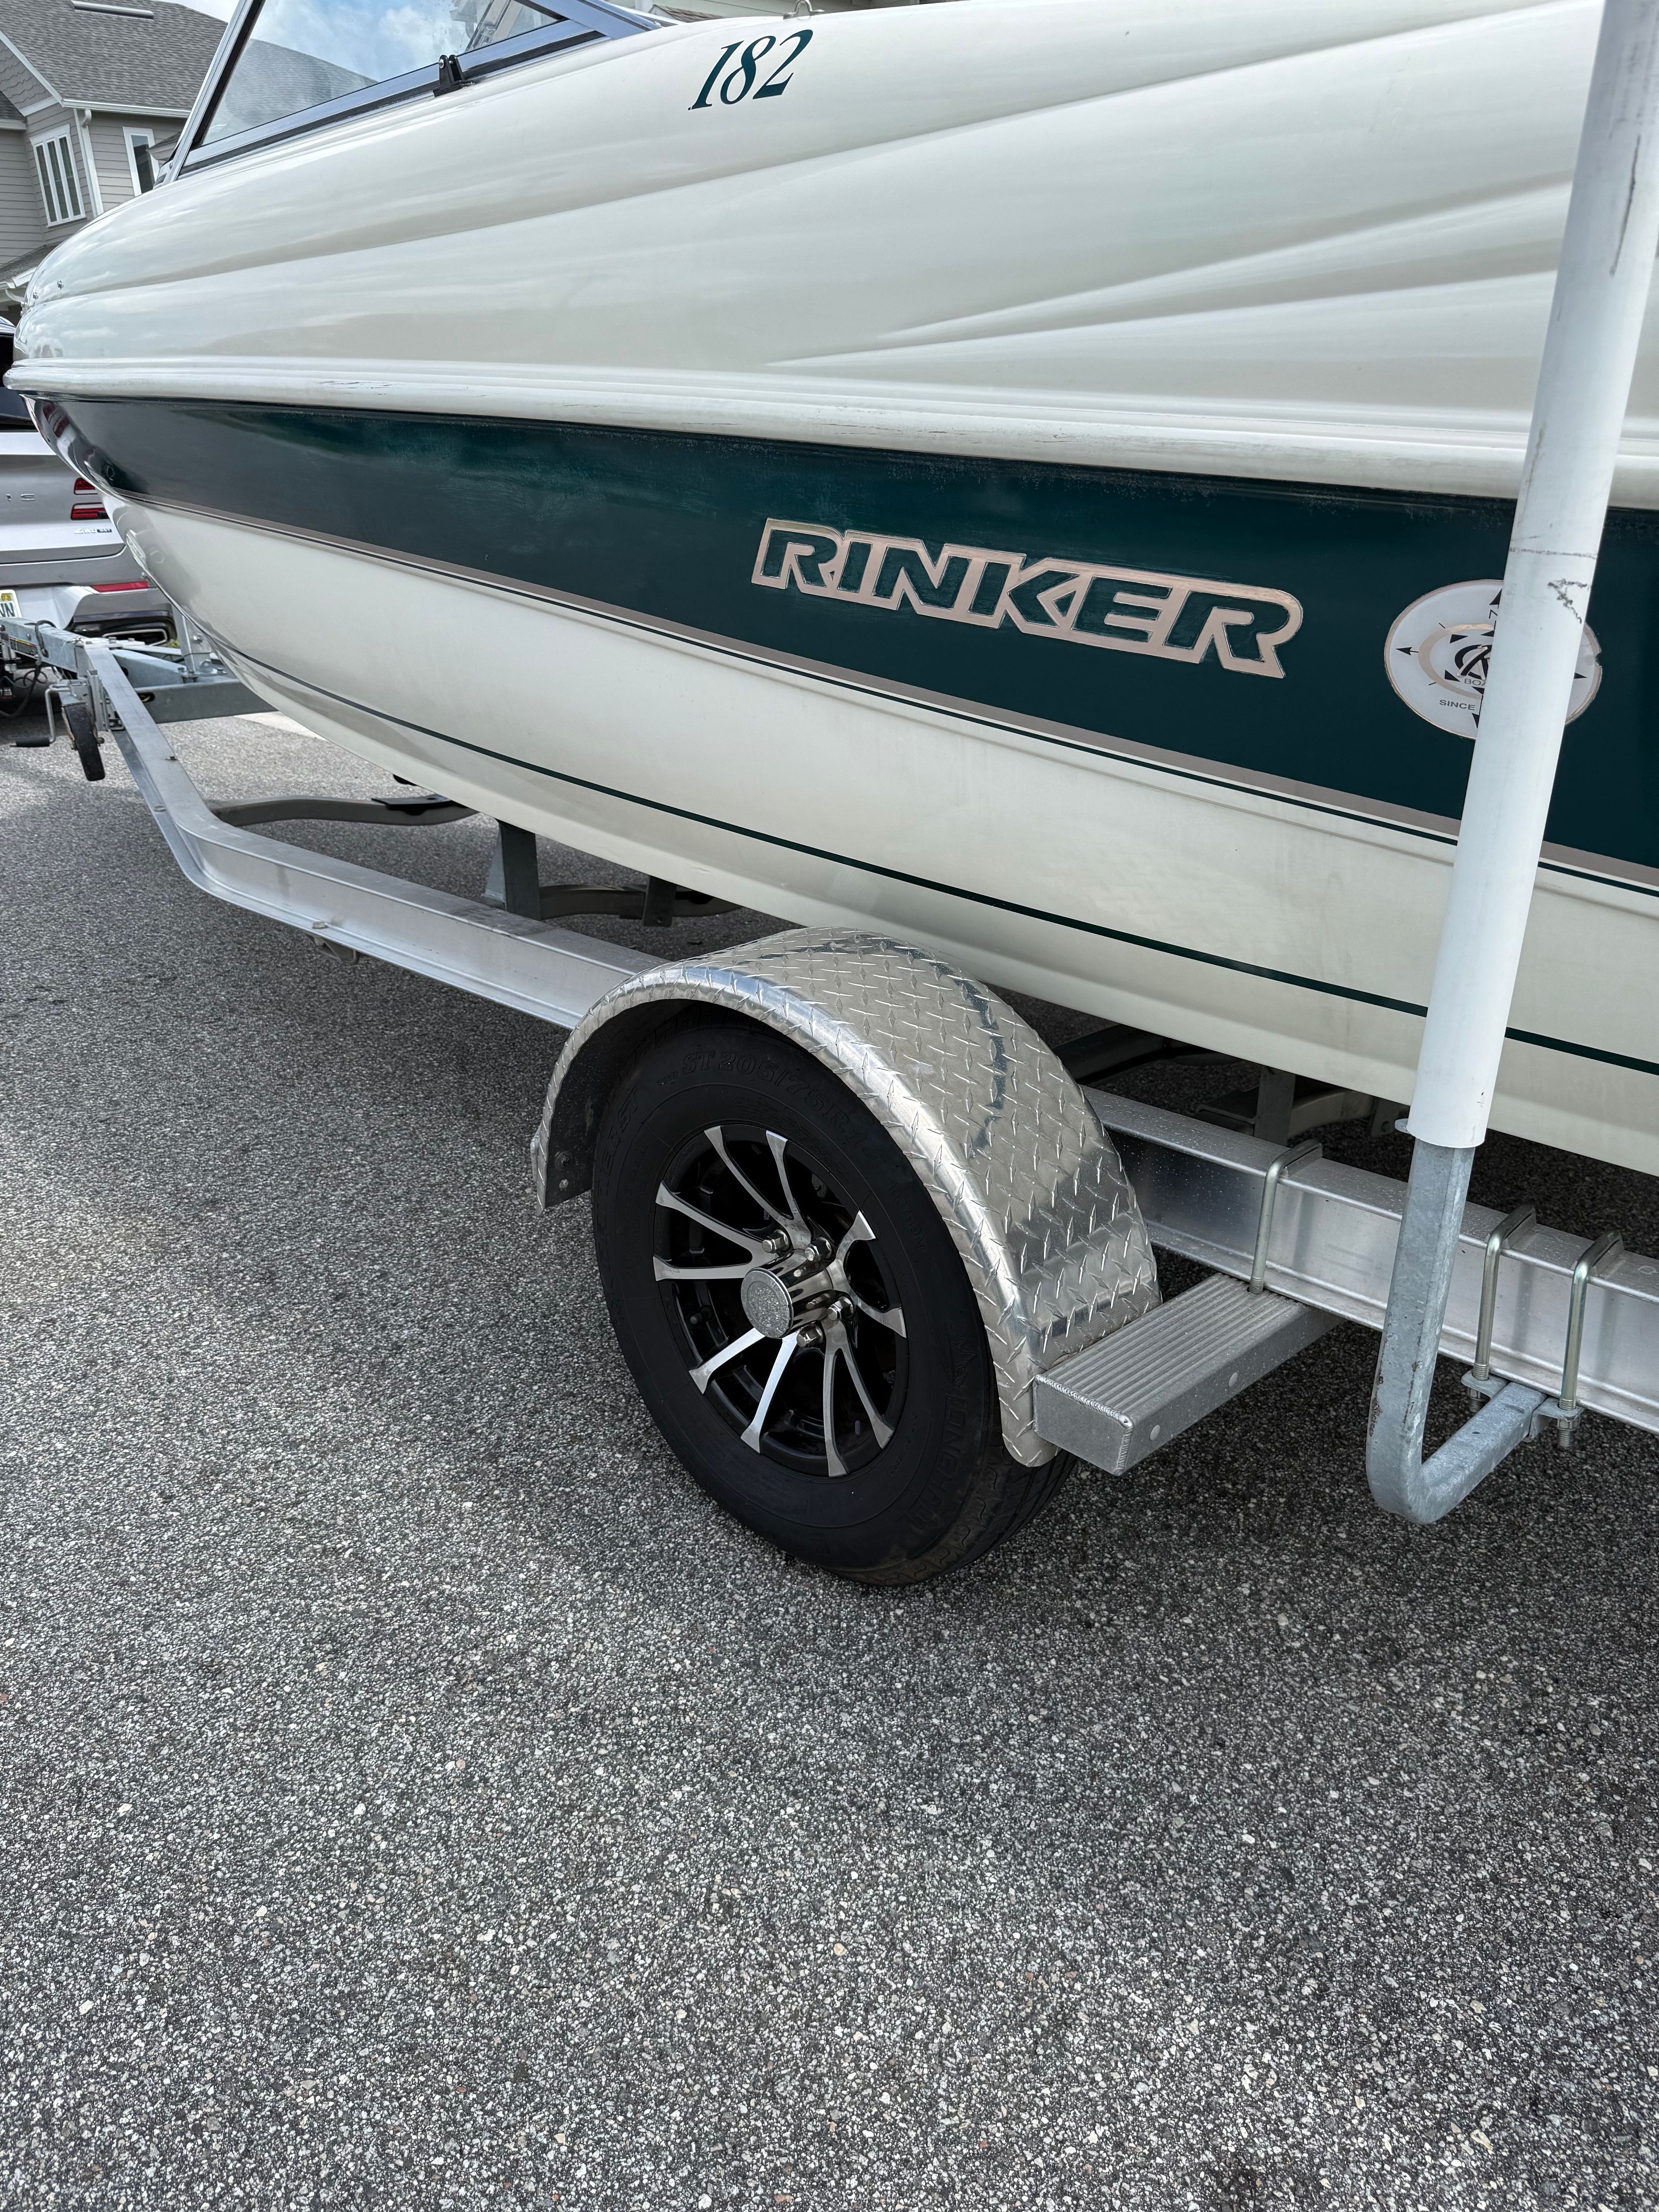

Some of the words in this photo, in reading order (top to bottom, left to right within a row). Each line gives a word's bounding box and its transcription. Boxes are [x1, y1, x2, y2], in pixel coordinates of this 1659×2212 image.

[688, 29, 813, 110] 182
[751, 518, 1303, 678] RINKER
[1439, 699, 1475, 711] SINCE
